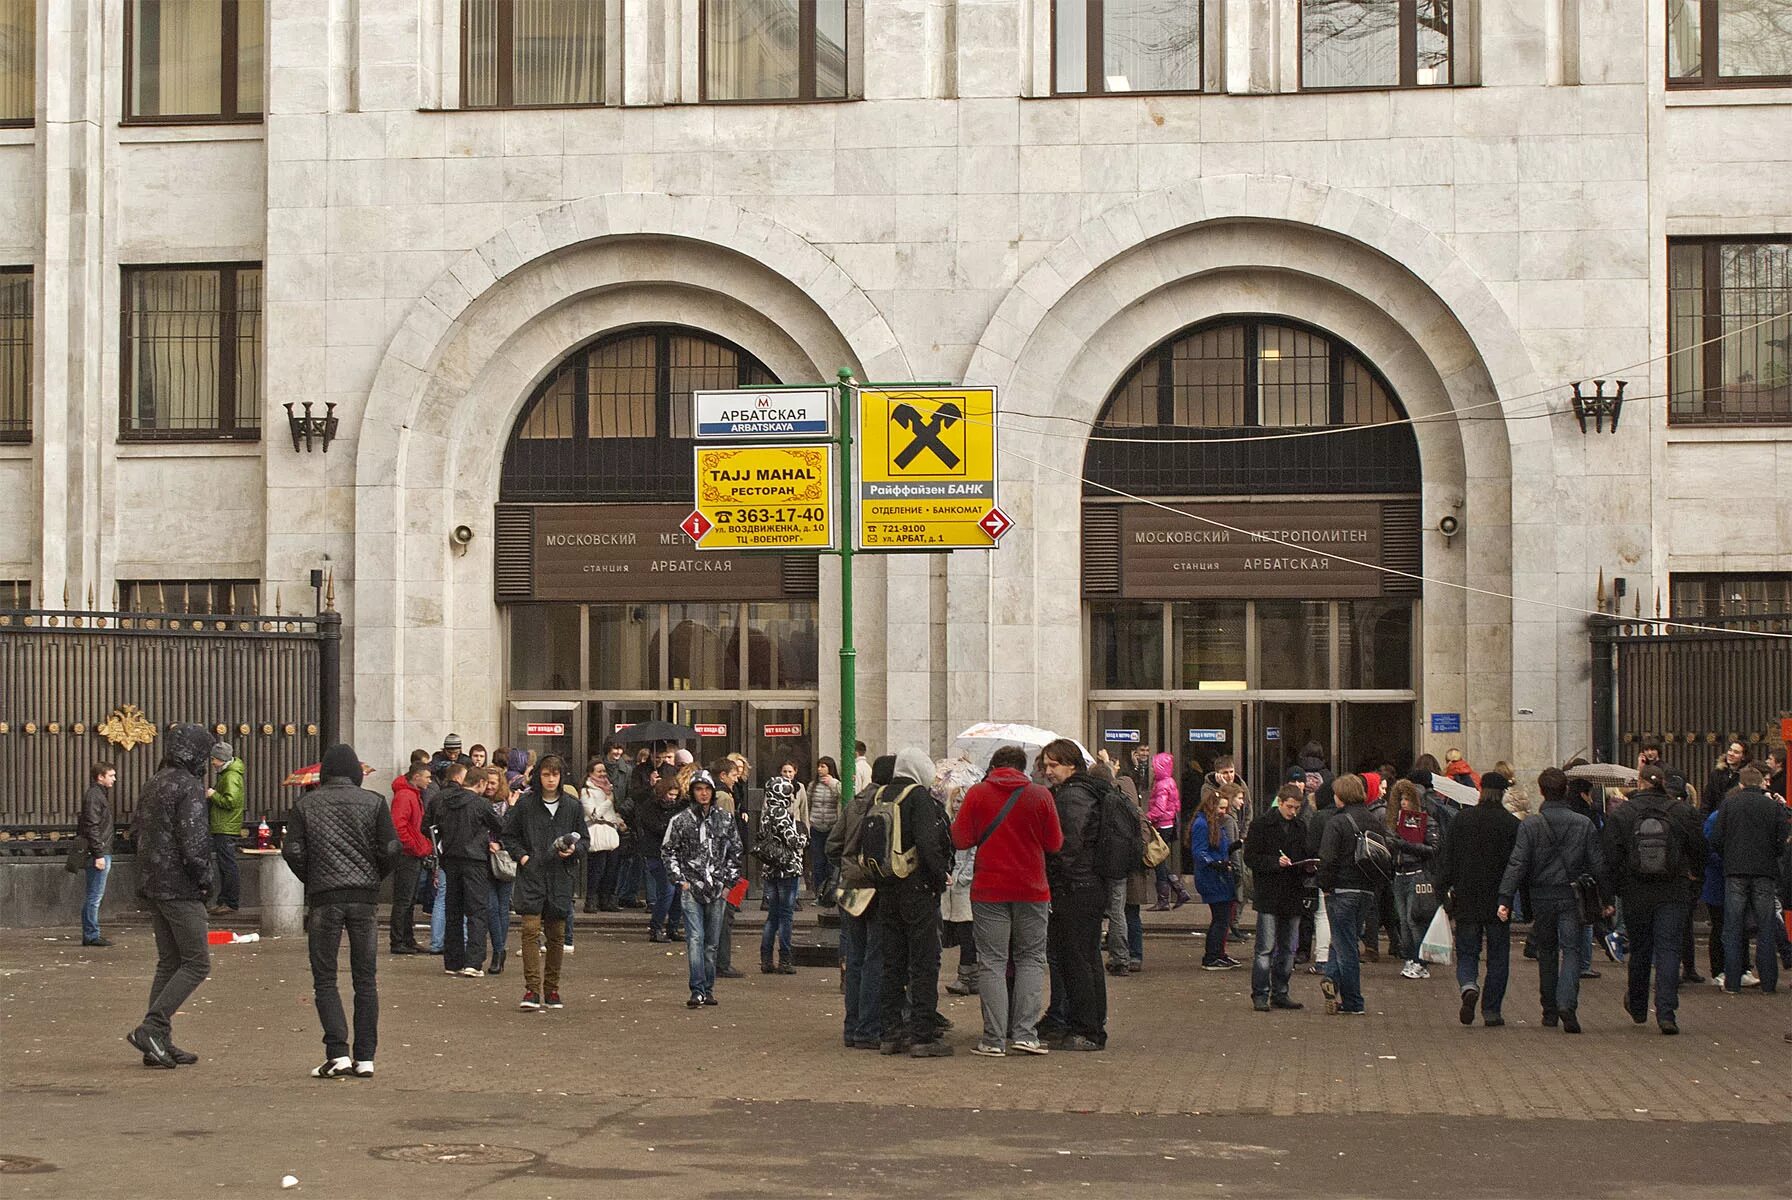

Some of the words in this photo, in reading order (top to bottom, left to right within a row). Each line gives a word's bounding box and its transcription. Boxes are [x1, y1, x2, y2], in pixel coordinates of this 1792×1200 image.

[720, 408, 806, 422] АРБАТСКАЯ
[731, 422, 794, 432] ARBATSKAYA
[710, 470, 751, 482] TAJJ
[756, 468, 816, 480] MAHAL
[732, 487, 794, 496] РЕСТОРАН
[870, 485, 946, 497] Райффайзен
[948, 484, 984, 494] БАНК
[736, 508, 824, 522] 363-17-40
[872, 506, 922, 515] ОТДЕЛЕНИЕ
[932, 506, 982, 514] БАНКОМАТ
[728, 524, 802, 534] ВОЗДВИЖЕНКА,
[546, 532, 636, 546] МОСКОВСКИЙ
[736, 536, 748, 544] ТЦ
[1135, 530, 1230, 544] МОСКОВСКИЙ
[1250, 530, 1367, 542] МЕТРОПОЛИТЕН
[650, 560, 732, 572] АРБАТСКАЯ
[1244, 558, 1330, 570] АРБАТСКАЯ
